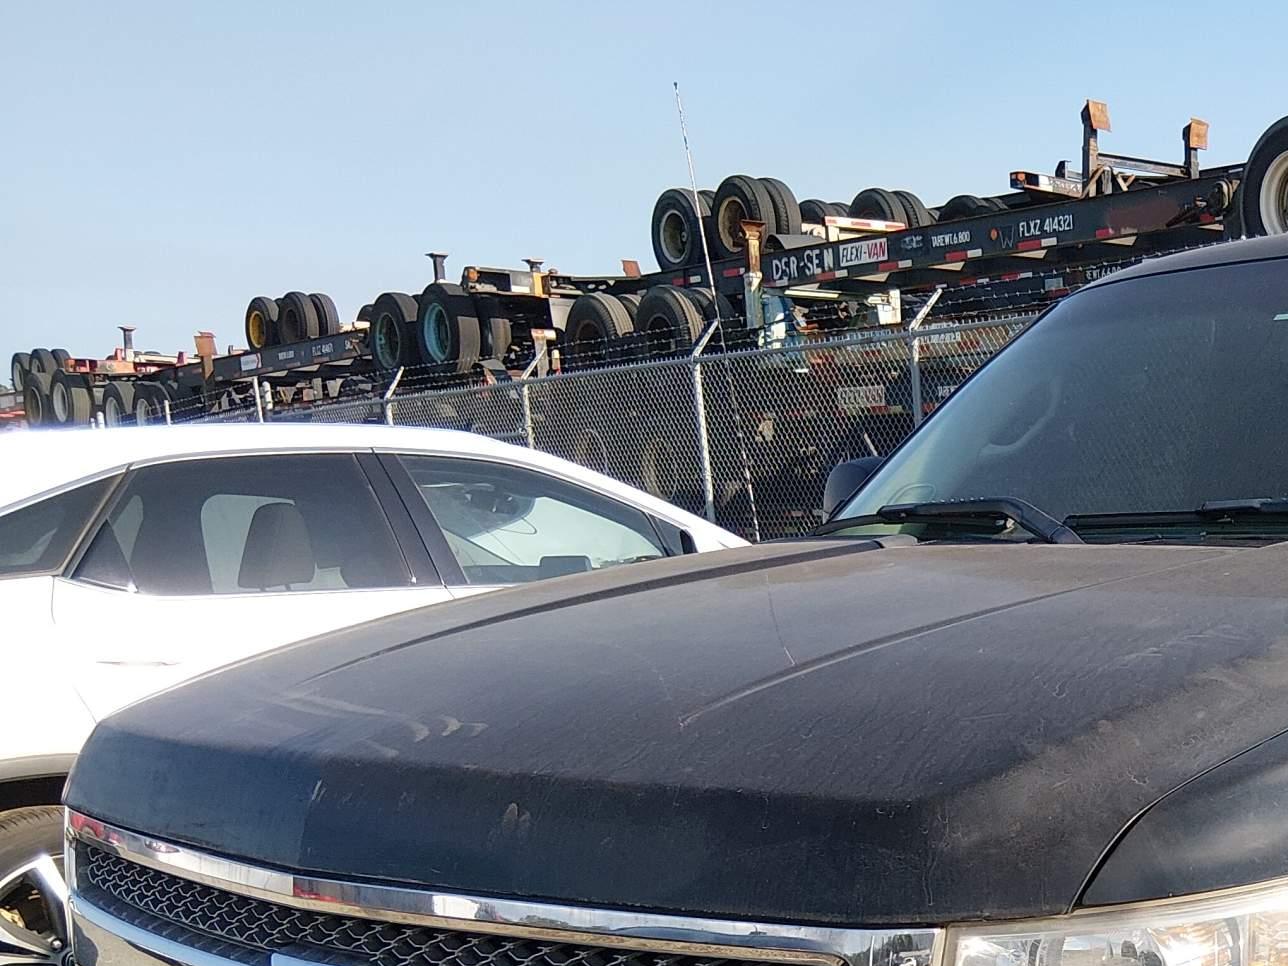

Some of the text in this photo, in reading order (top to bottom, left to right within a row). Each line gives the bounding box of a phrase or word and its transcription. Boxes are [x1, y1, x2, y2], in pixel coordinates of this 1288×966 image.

[1019, 214, 1074, 238] FLXZ 414321
[841, 240, 886, 264] FLEXI-VAN
